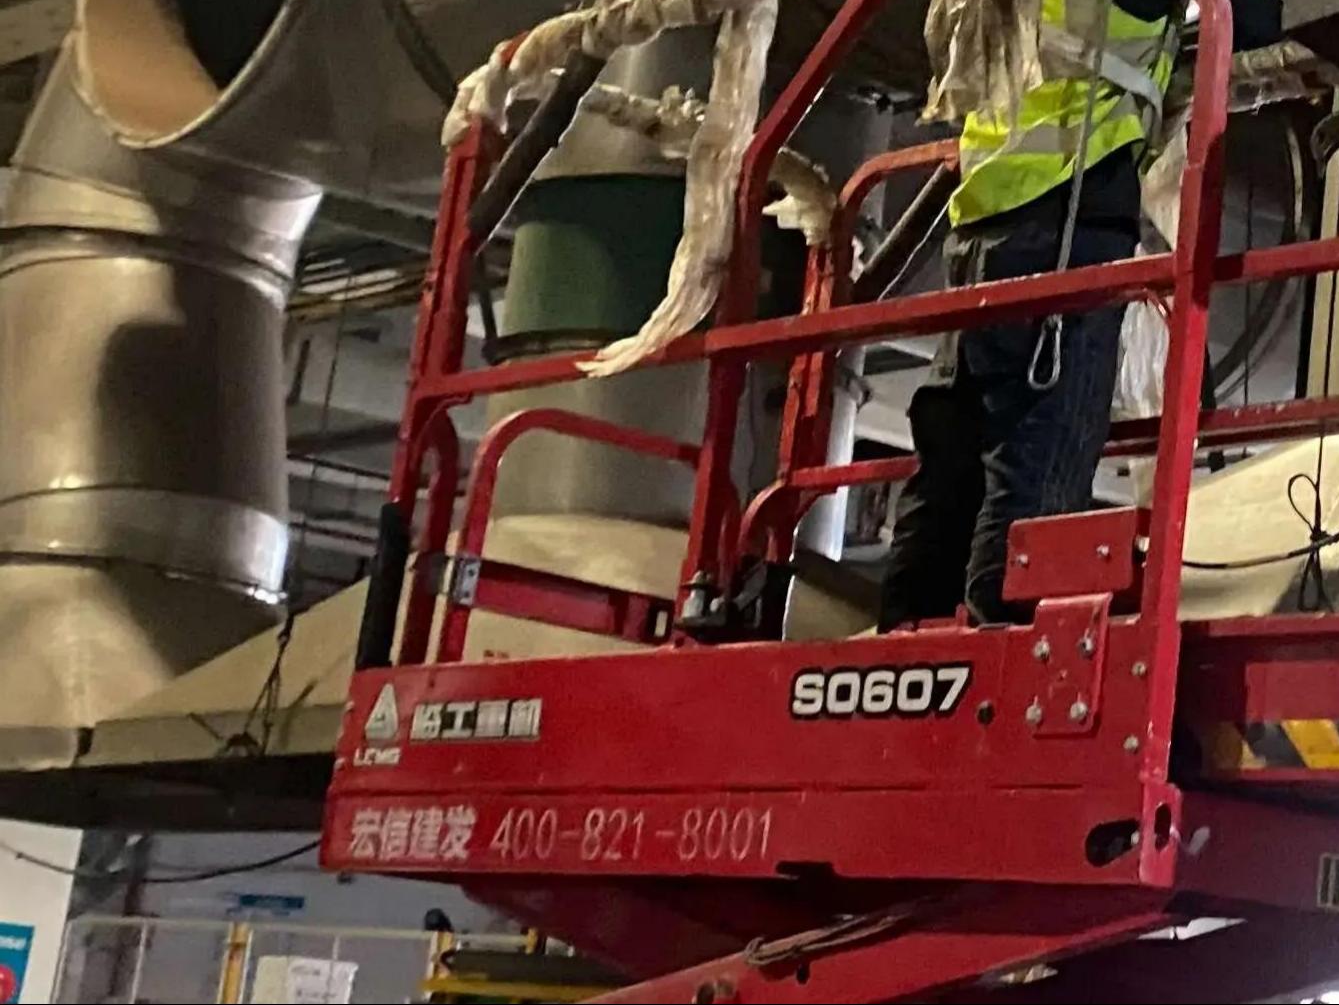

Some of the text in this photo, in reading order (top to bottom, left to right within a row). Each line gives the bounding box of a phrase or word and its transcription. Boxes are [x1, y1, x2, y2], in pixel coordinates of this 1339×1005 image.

[349, 804, 772, 861] 宏信建发 400-821-8001
